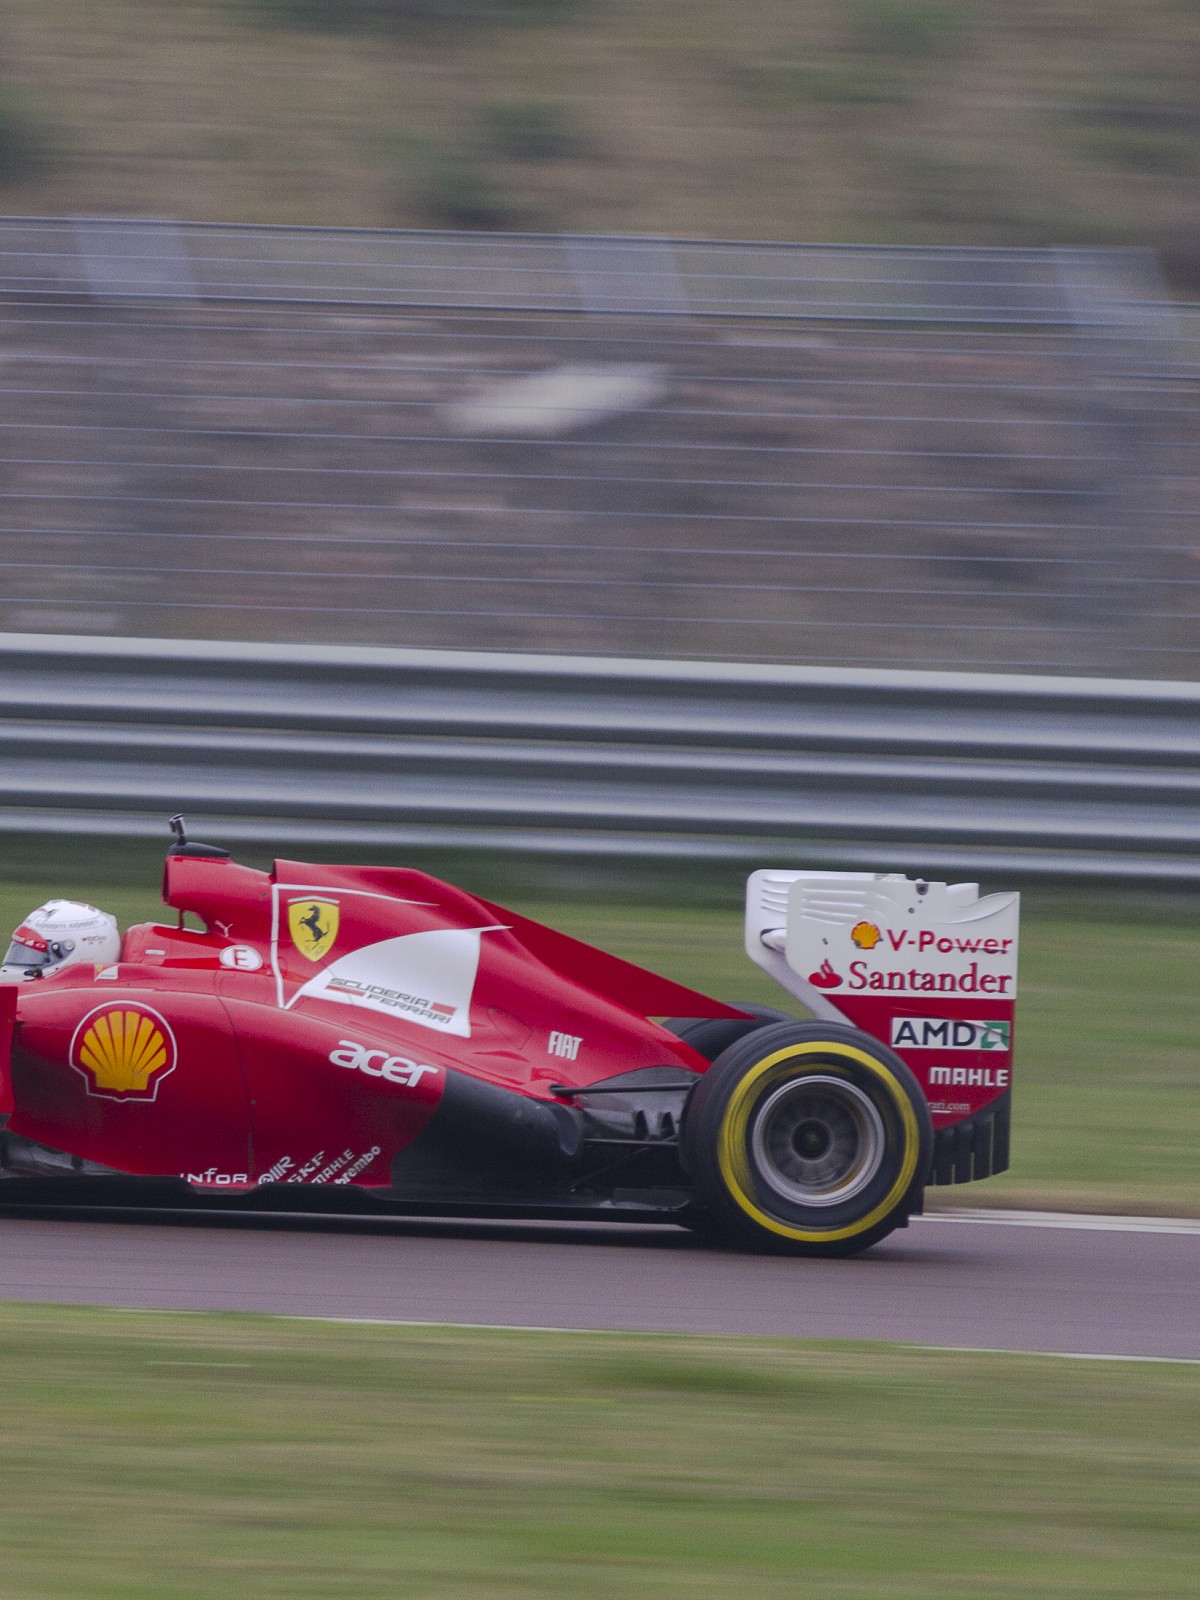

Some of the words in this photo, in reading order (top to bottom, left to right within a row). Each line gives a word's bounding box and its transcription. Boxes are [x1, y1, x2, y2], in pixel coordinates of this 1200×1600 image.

[887, 929, 1013, 954] V-Power
[848, 961, 1012, 993] Santander
[330, 978, 431, 1008] SCUDERIA
[366, 993, 452, 1024] FERRARI
[548, 1031, 583, 1060] FIAT
[893, 1021, 978, 1046] AMD
[328, 1039, 438, 1087] acer
[929, 1066, 1009, 1087] MAHLE
